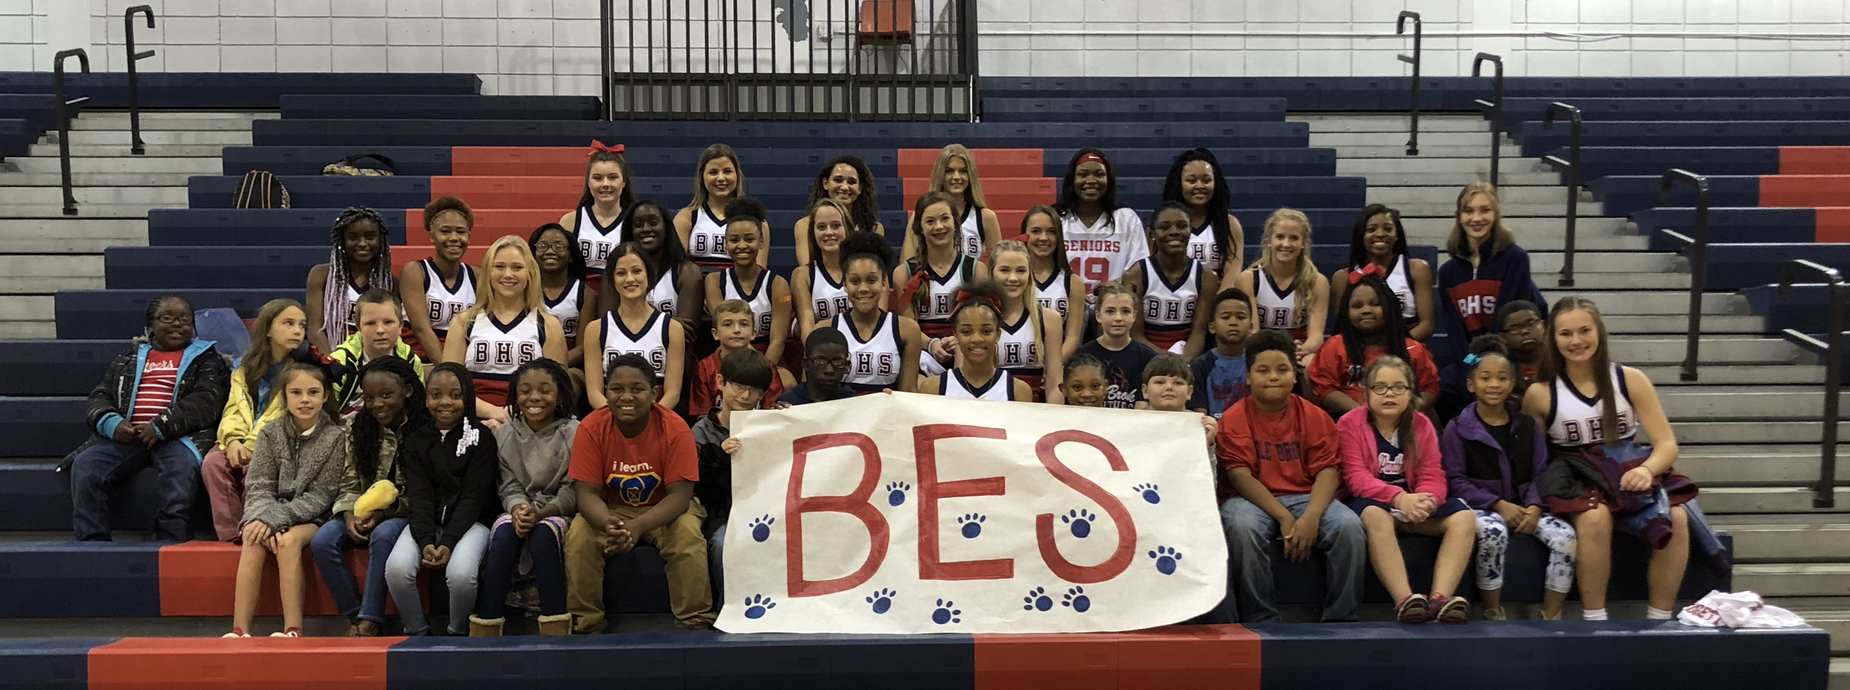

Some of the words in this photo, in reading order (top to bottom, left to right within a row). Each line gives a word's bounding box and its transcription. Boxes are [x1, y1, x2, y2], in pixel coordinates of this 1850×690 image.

[694, 233, 727, 255] BH
[1064, 239, 1121, 252] SENIORS
[816, 297, 850, 320] BH
[1457, 295, 1497, 318] BHS
[474, 340, 536, 365] BHS
[849, 351, 893, 377] HS
[612, 461, 618, 471] i
[620, 461, 653, 472] learn.
[785, 423, 1137, 598] BES
